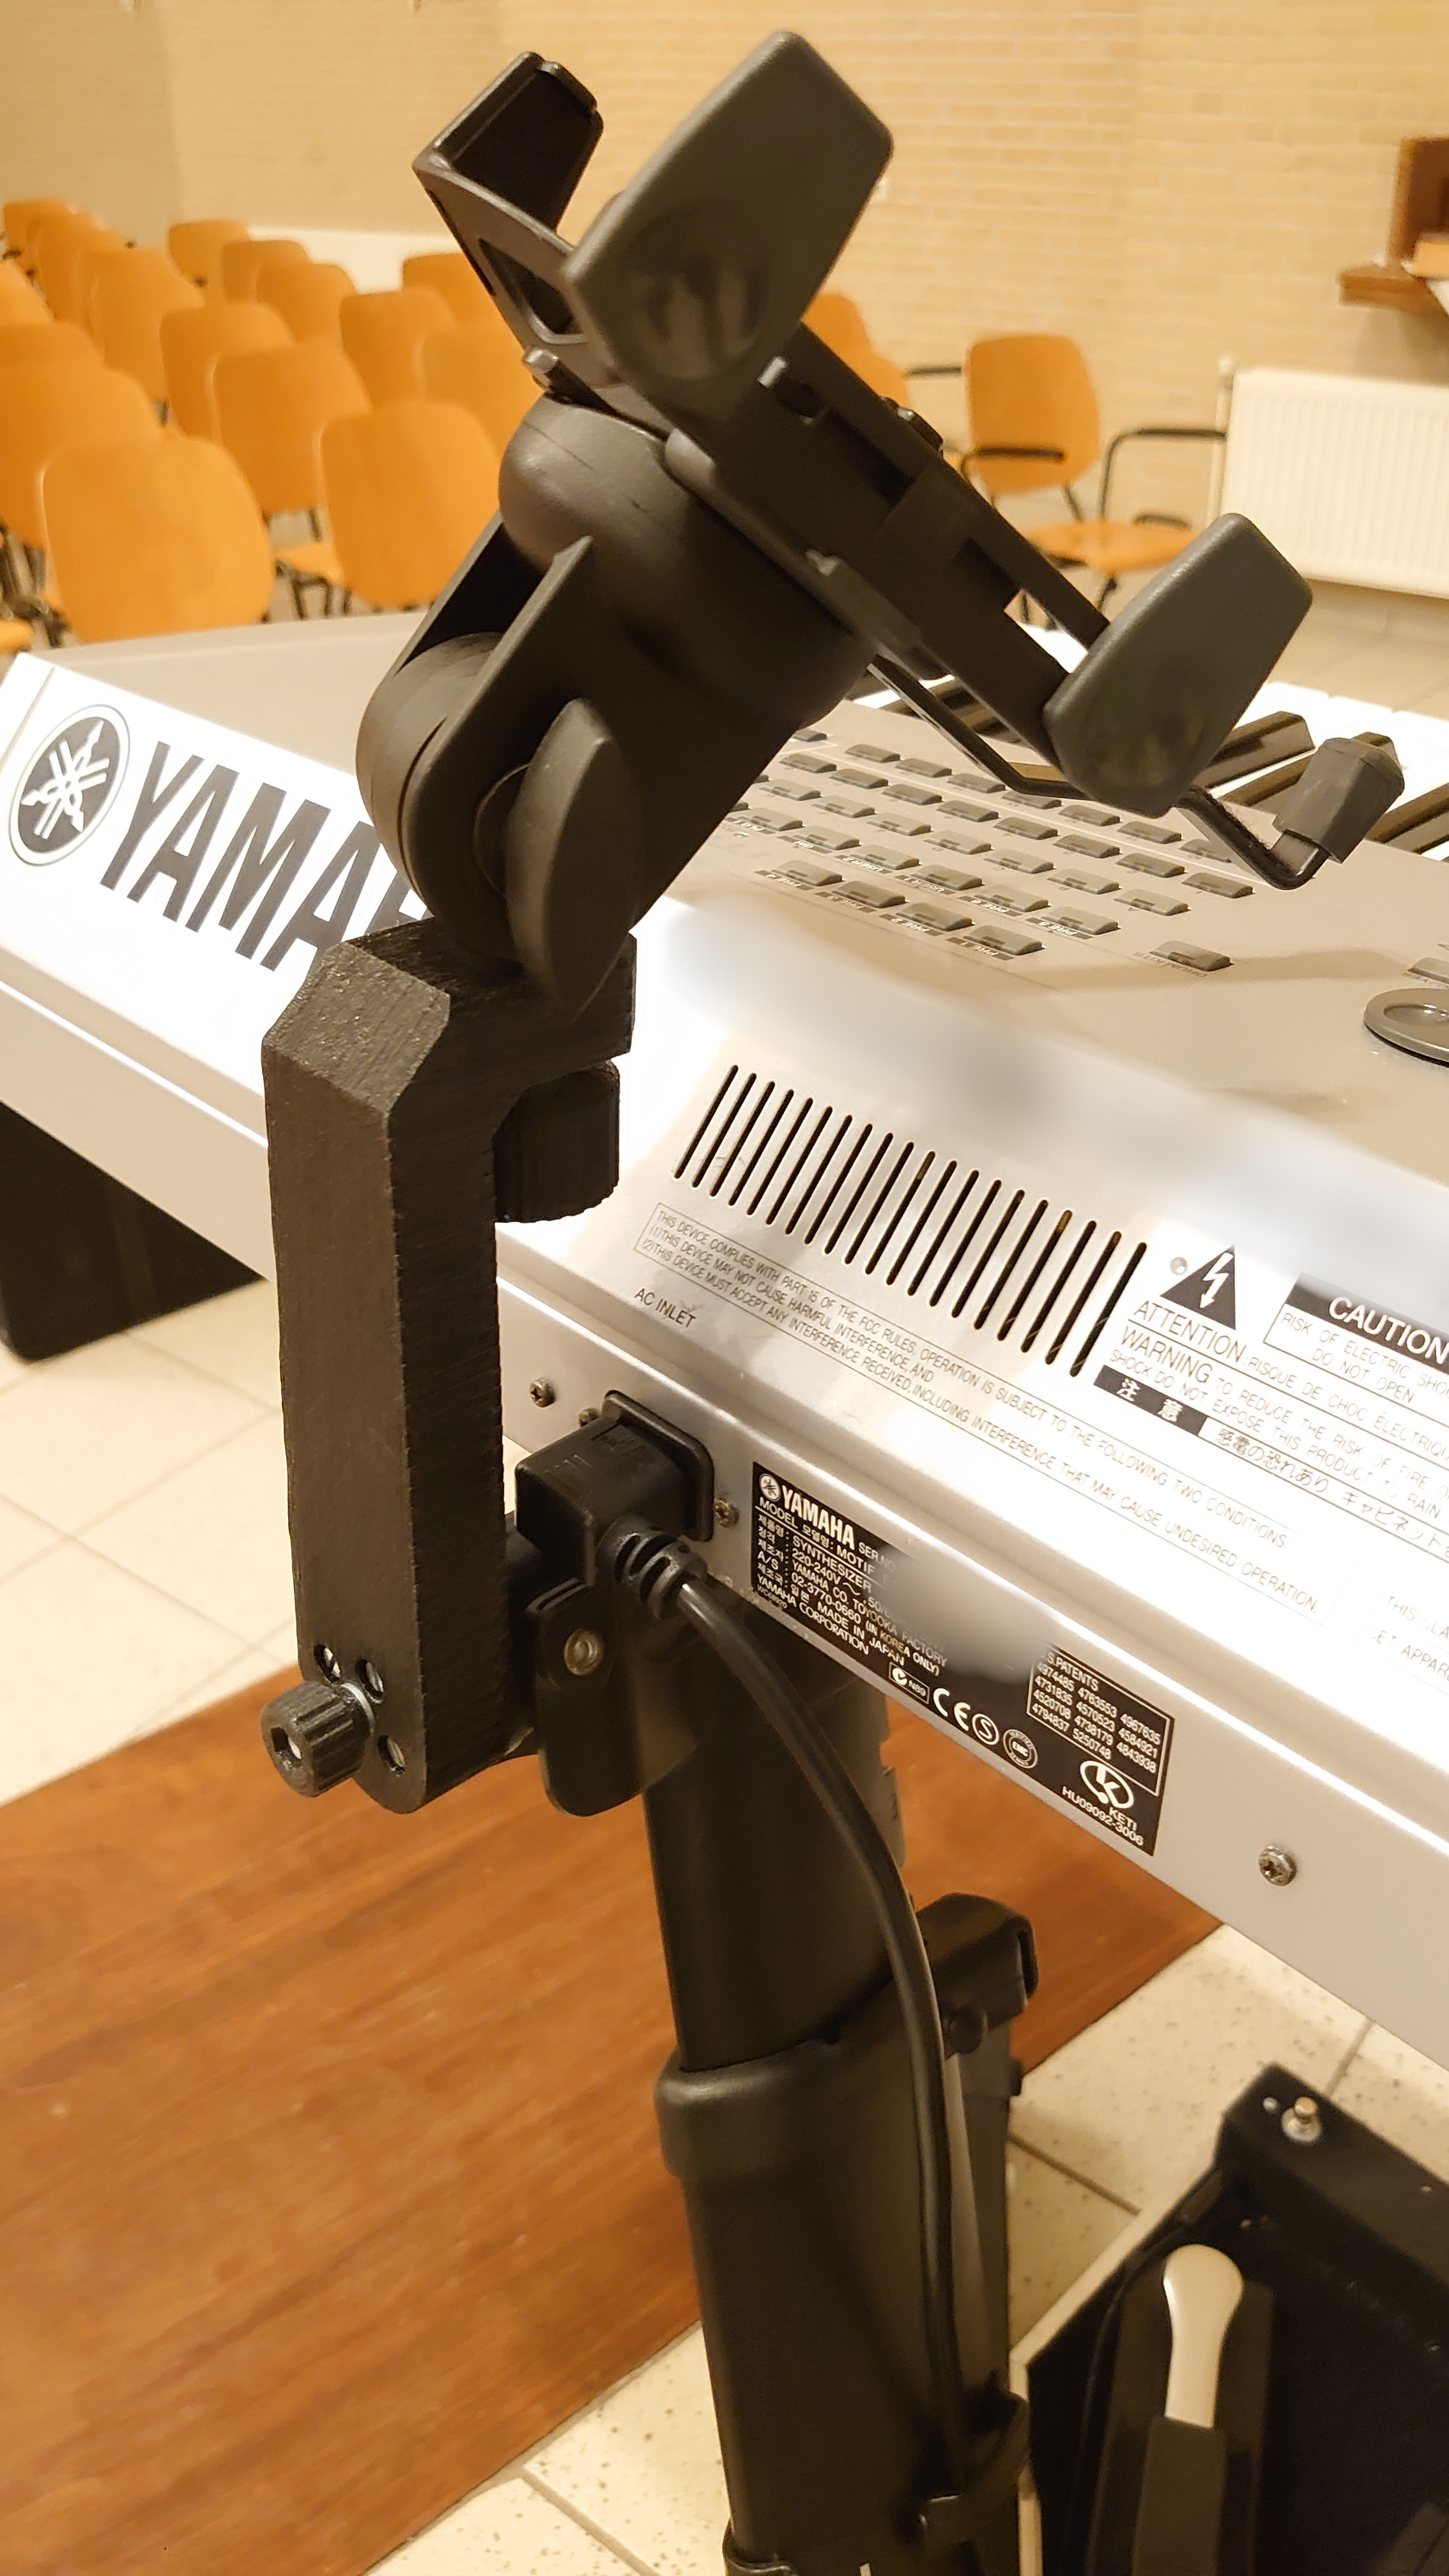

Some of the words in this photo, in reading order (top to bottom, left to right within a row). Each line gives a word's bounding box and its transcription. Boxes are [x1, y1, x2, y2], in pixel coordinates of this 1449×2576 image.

[776, 877, 802, 887] PRE
[852, 860, 884, 871] USER
[901, 922, 930, 932] PRE
[981, 903, 1009, 913] PRE
[1048, 924, 1078, 936] PRE
[972, 946, 999, 956] PRE
[634, 1287, 655, 1306] AC
[656, 1298, 696, 1328] INLET
[680, 1241, 713, 1265] DEVICE
[714, 1258, 733, 1276] MAY
[735, 1271, 757, 1287] NOT
[757, 1282, 787, 1305] CAUSE
[788, 1296, 831, 1330] HARMFUL
[910, 1363, 935, 1383] AND
[1329, 1296, 1449, 1365] CAUTION
[657, 1211, 675, 1228] THIS
[677, 1222, 710, 1245] DEVICE
[710, 1239, 755, 1269] COMPLIES
[756, 1262, 781, 1282] WITH
[782, 1276, 808, 1296] PART
[808, 1290, 818, 1302] 15
[820, 1296, 836, 1309] OF
[838, 1305, 861, 1323] THE
[859, 1316, 881, 1335] FCC
[919, 1348, 981, 1388] OPERATION
[981, 1380, 995, 1395] IS
[995, 1387, 1047, 1422] SUBJECT
[1050, 1414, 1067, 1432] TO
[1071, 1425, 1094, 1447] THE
[1096, 1440, 1169, 1486] FOLLOWING
[1174, 1478, 1202, 1503] TWO
[1281, 1312, 1314, 1335] RISK
[1319, 1330, 1339, 1344] OF
[1344, 1340, 1411, 1379] ELECTRIC
[1416, 1372, 1449, 1399] SHO
[1312, 1348, 1333, 1366] DO
[1339, 1360, 1370, 1382] NOT
[1376, 1377, 1414, 1404] OPEN
[673, 1254, 706, 1278] DEVICE
[707, 1272, 732, 1292] MUST
[730, 1287, 769, 1311] ACCEPT
[766, 1307, 789, 1323] ANY
[788, 1317, 861, 1363] INTERFERENCE
[912, 1383, 970, 1423] INCLUDING
[971, 1415, 1057, 1469] INTERFERENCE
[1057, 1462, 1091, 1485] THAT
[1091, 1480, 1119, 1501] MAY
[1120, 1496, 1162, 1526] CAUSE
[1165, 1520, 1238, 1567] UNDESIRED
[1121, 1326, 1213, 1384] WARNING
[1216, 1377, 1233, 1395] TO
[1238, 1390, 1293, 1423] REDUCE
[1301, 1417, 1326, 1440] THE
[1332, 1434, 1365, 1458] RISK
[1372, 1453, 1392, 1469] OF
[1398, 1466, 1430, 1491] FIRE
[1437, 1485, 1449, 1501] O
[1247, 1357, 1297, 1388] RISQUE
[1301, 1382, 1323, 1400] DE
[1327, 1395, 1368, 1421] CHOC
[1110, 1349, 1153, 1377] SHOCK
[1154, 1371, 1174, 1388] DO
[1179, 1383, 1208, 1403] NOT
[1212, 1399, 1264, 1432] EXPOSE
[1272, 1427, 1301, 1450] THIS
[1307, 1445, 1373, 1482] PRODUCT
[1381, 1480, 1399, 1498] TO
[1406, 1492, 1442, 1519] RAIN
[759, 1496, 799, 1529] MODEL
[836, 1544, 875, 1575] MOTIF
[782, 1485, 855, 1551] YAMAHA
[792, 1535, 872, 1594] SYNTHESIZER
[792, 1547, 841, 1584] 220-240V
[757, 1551, 779, 1570] A/S
[792, 1572, 861, 1624] 02-3770-0660
[865, 1620, 878, 1636] (IN
[880, 1630, 910, 1657] KOREA
[913, 1652, 940, 1676] ONLY)
[757, 1573, 797, 1607] YAMAHA
[799, 1602, 869, 1655] CORPORATION
[792, 1560, 829, 1591] YAMAHA
[852, 1598, 898, 1636] TOYOOKA
[901, 1630, 947, 1667] FACTORY
[817, 1601, 849, 1630] MADE
[853, 1625, 865, 1640] IN
[869, 1637, 905, 1666] JAPAN
[1387, 1595, 1417, 1621] THIS
[1400, 1644, 1449, 1682] APPAR
[933, 1687, 970, 1731] CE
[1032, 1703, 1070, 1732] 4794837
[1073, 1728, 1112, 1761] 5250748
[1033, 1689, 1071, 1720] 4520708
[1074, 1715, 1114, 1746] 4738179
[1116, 1742, 1157, 1774] 4843938
[1034, 1675, 1073, 1706] 4731835
[1075, 1701, 1116, 1732] 4570523
[1118, 1728, 1158, 1758] 4584921
[1078, 1687, 1117, 1719] 4763553
[1120, 1713, 1161, 1745] 4967635
[1062, 1786, 1144, 1846] HU09092-3006
[1108, 1807, 1138, 1831] KETI
